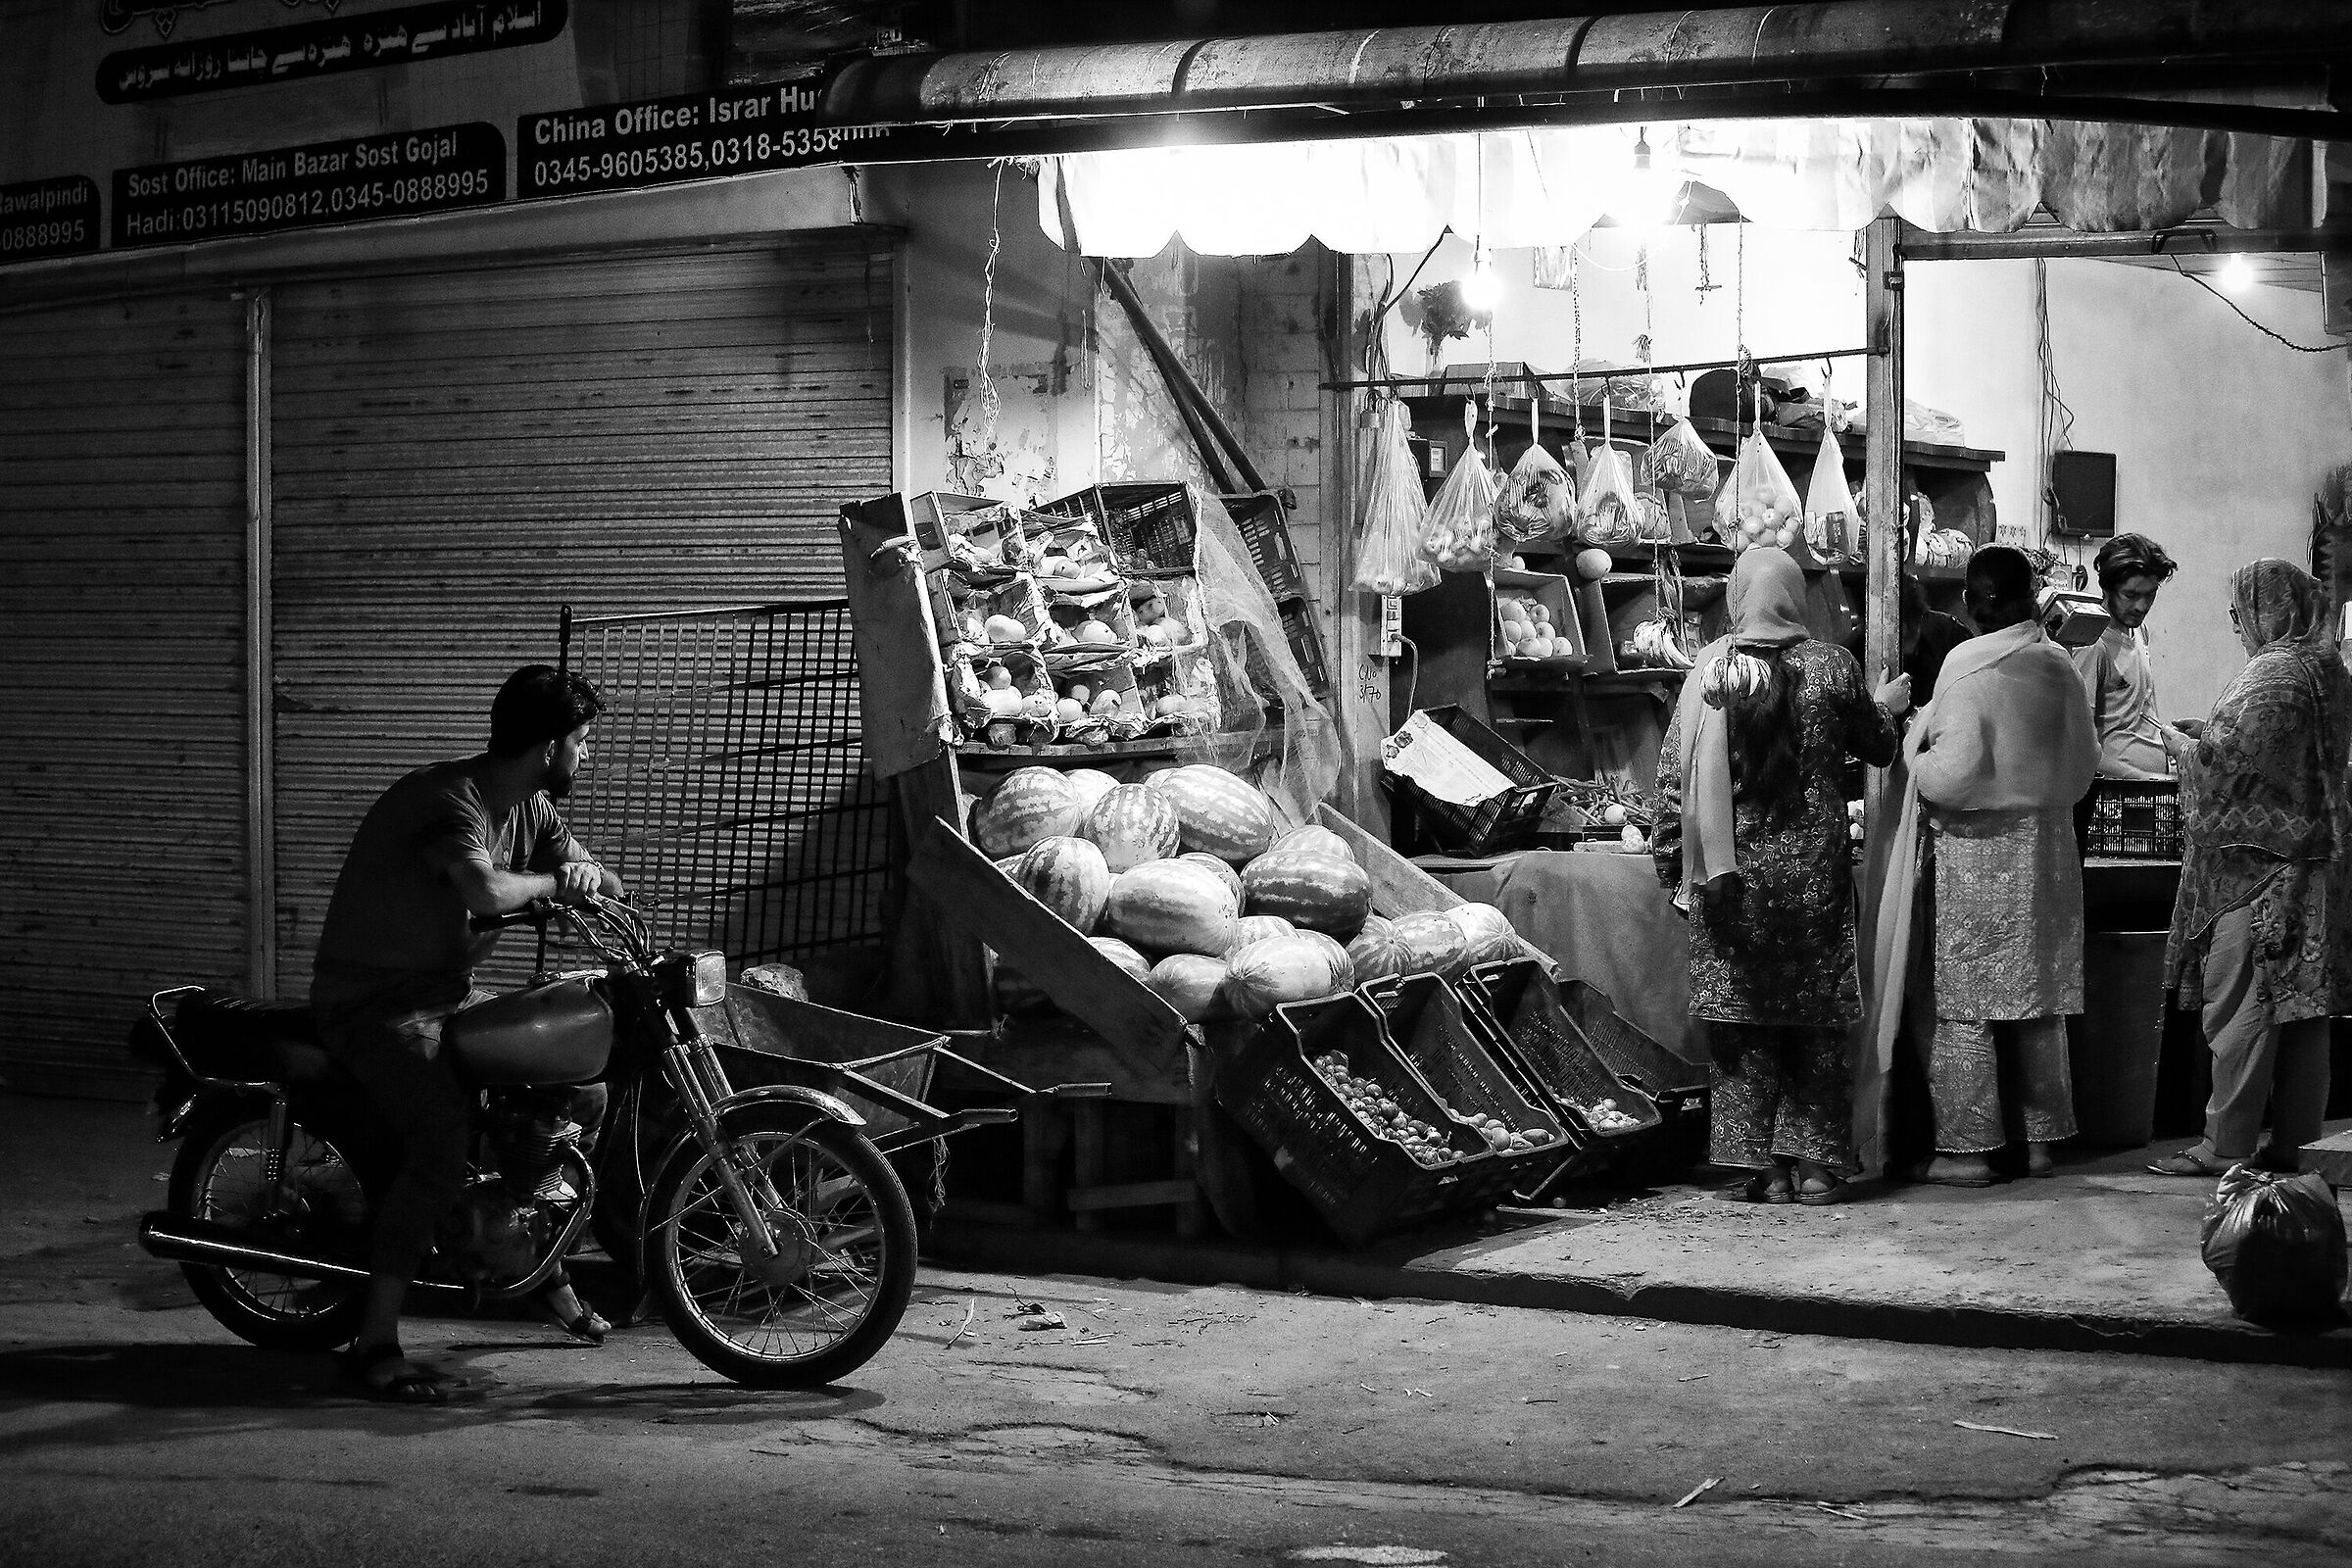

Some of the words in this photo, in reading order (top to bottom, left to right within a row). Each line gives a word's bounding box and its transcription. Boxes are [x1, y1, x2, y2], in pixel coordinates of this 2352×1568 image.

[534, 115, 607, 145] China
[613, 104, 700, 135] Office:
[709, 95, 771, 124] Israr
[779, 85, 823, 115] Hu
[127, 172, 169, 198] Sost
[174, 165, 235, 193] Office:
[241, 157, 287, 183] Main
[294, 150, 349, 177] Bazar
[354, 140, 399, 170] Sost
[405, 129, 458, 166] Gojal
